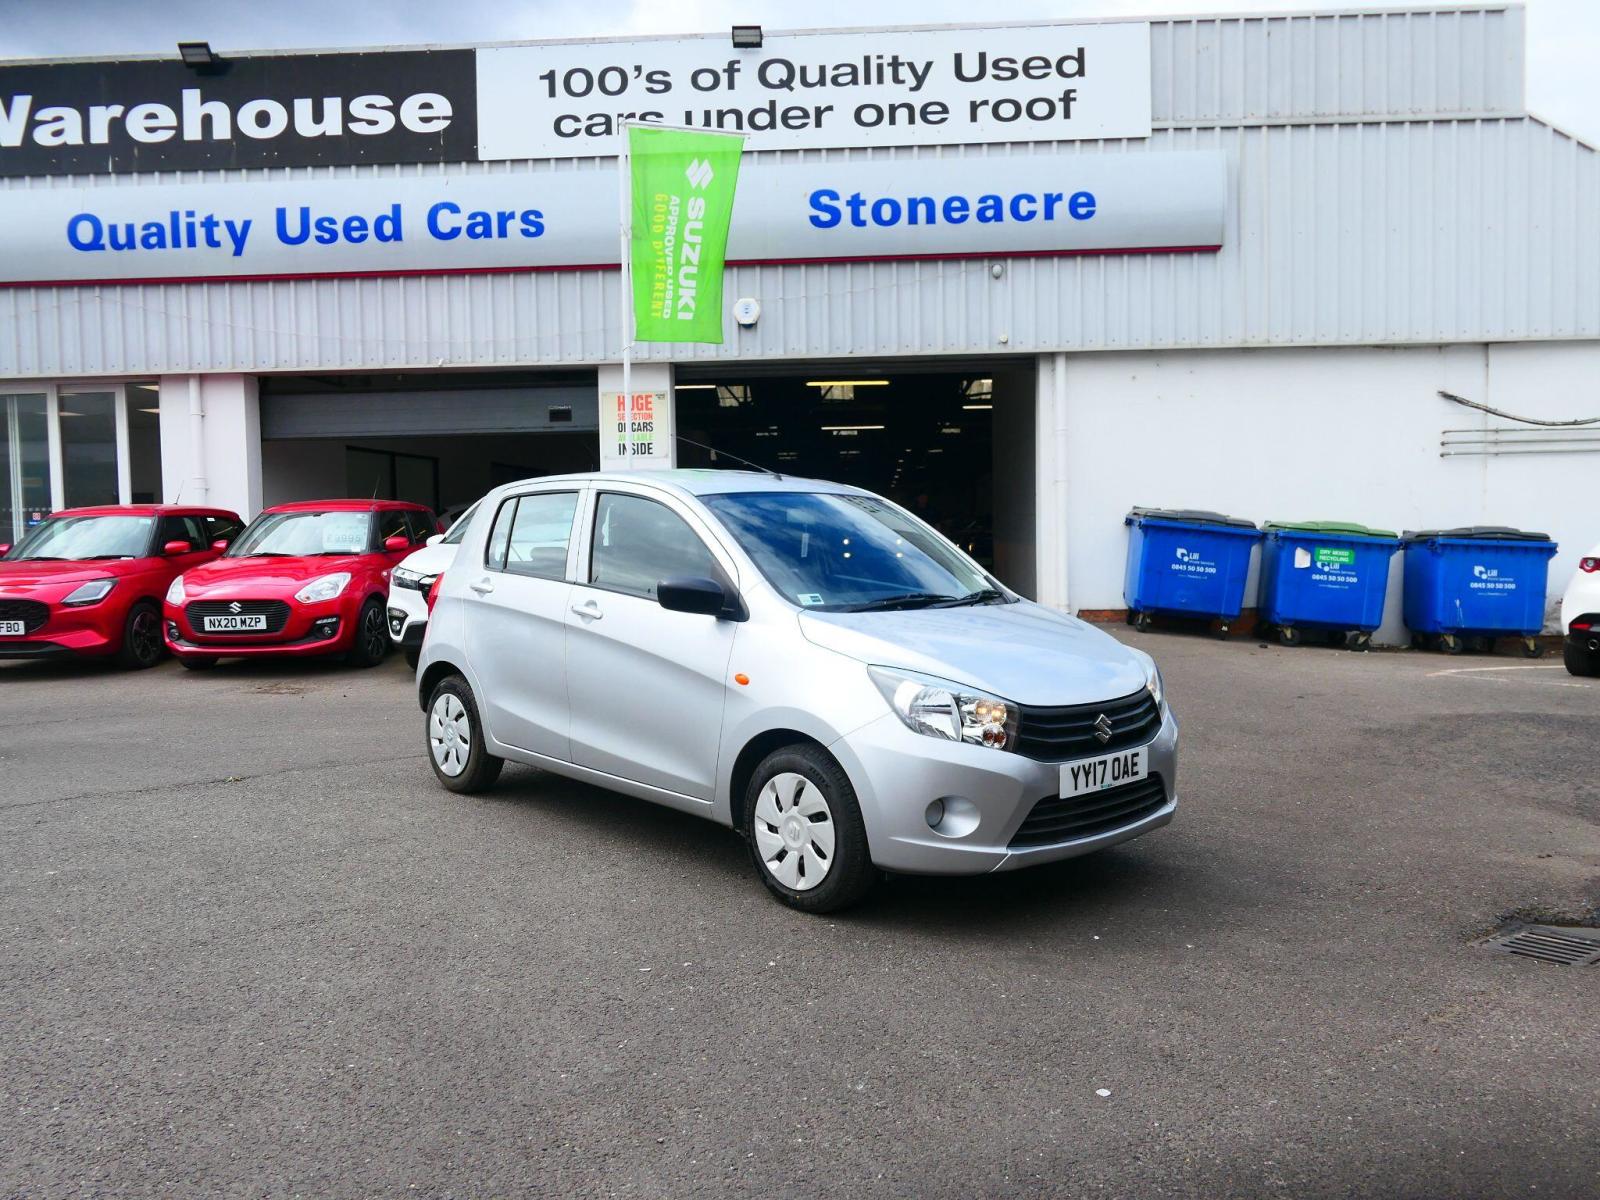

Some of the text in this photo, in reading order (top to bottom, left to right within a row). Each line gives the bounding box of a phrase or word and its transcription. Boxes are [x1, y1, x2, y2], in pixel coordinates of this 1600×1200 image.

[538, 47, 1086, 98] 100’s of Quality Used
[685, 100, 834, 132] under
[854, 100, 950, 128] one
[969, 88, 1078, 123] roof
[67, 201, 546, 256] Quality Used Cars
[653, 193, 668, 233] GOOD
[808, 186, 1097, 230] Stoneacre
[663, 195, 681, 319] APPROVED USED
[677, 196, 706, 320] SUZUKI
[631, 421, 654, 432] CARS
[209, 616, 261, 629] NX20 MZP
[1071, 752, 1140, 791] YY17 OAE
